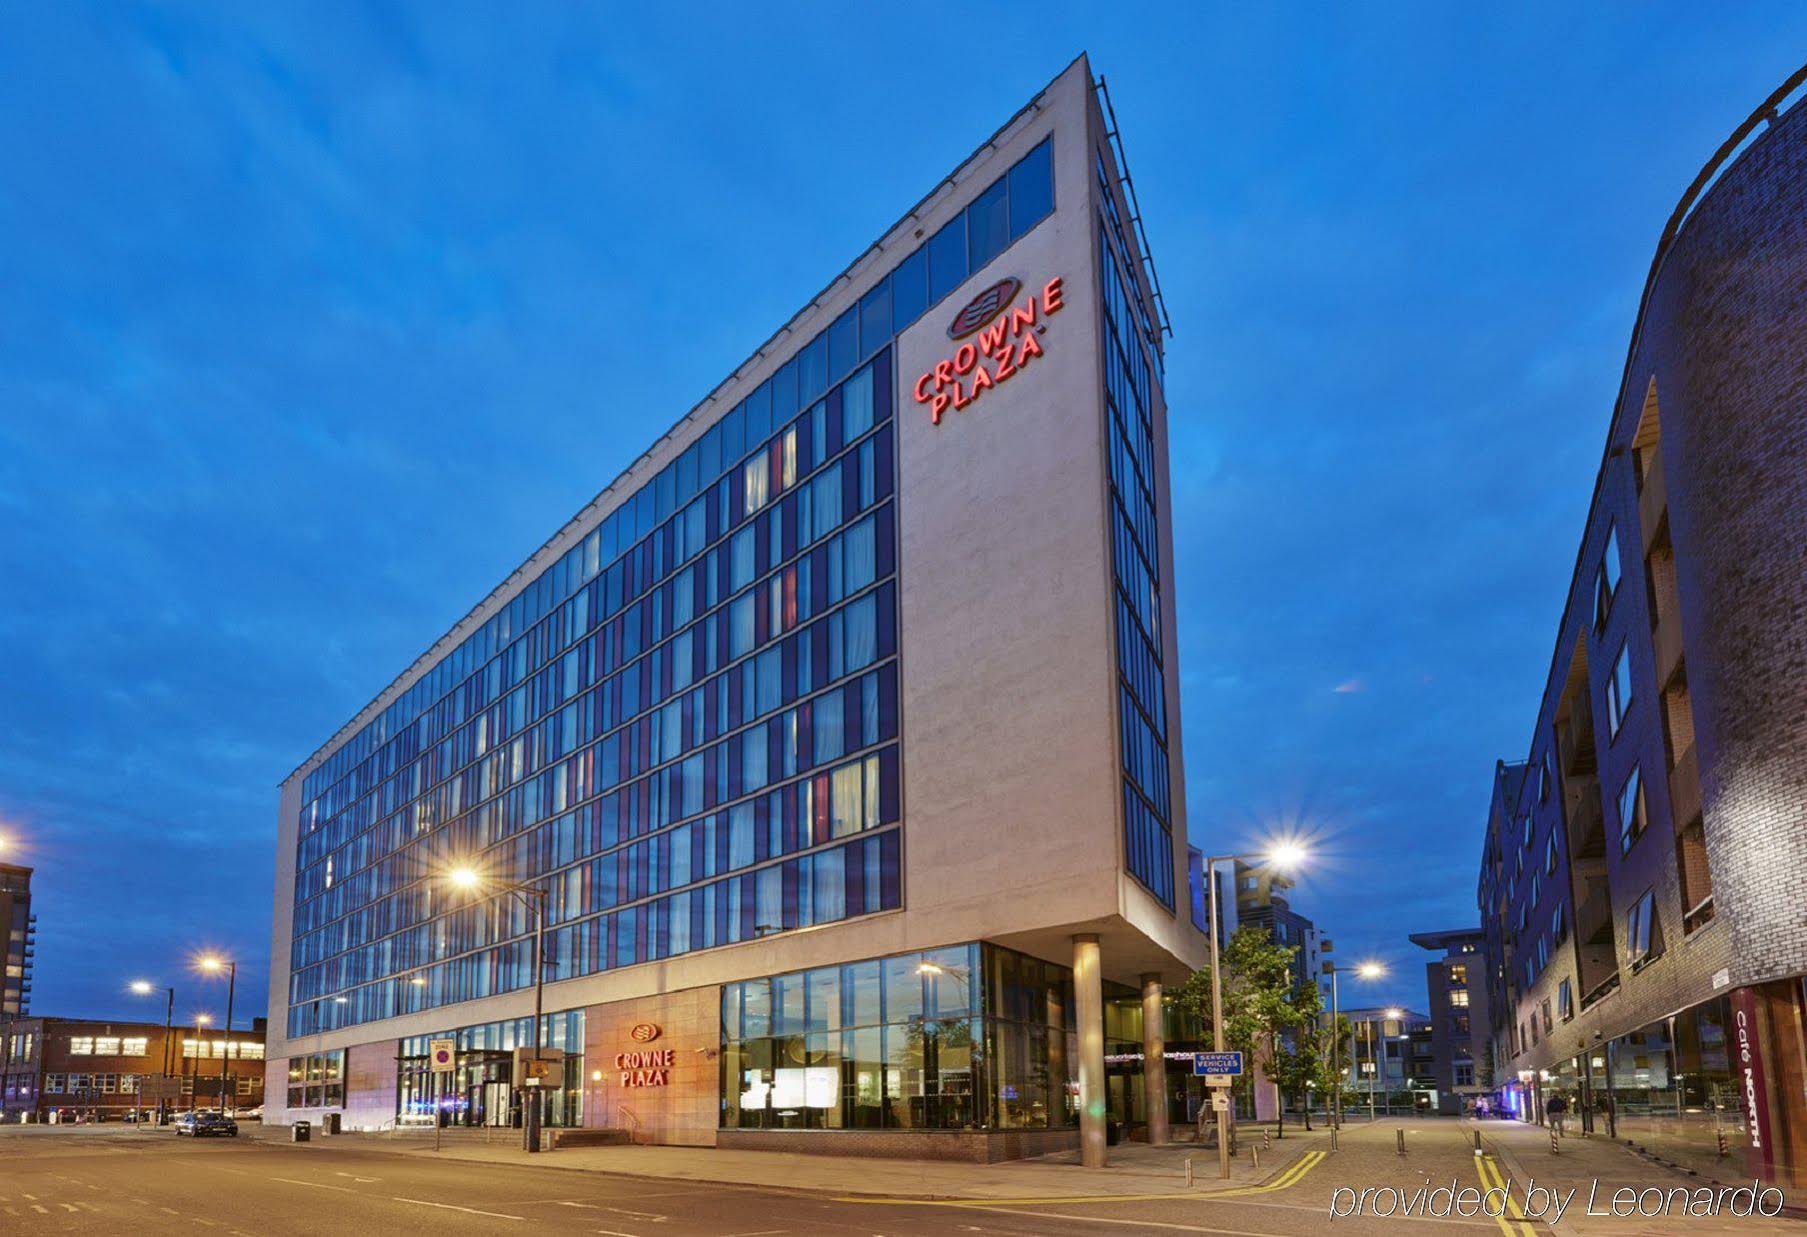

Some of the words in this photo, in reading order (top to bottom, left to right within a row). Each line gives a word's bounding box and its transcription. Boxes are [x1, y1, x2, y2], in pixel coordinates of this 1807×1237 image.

[914, 276, 1063, 403] CROWNE
[932, 332, 1043, 425] PLAZA
[615, 1049, 674, 1069] CROWNE
[621, 1069, 665, 1088] PLAZA
[1744, 1068, 1760, 1147] NORTH
